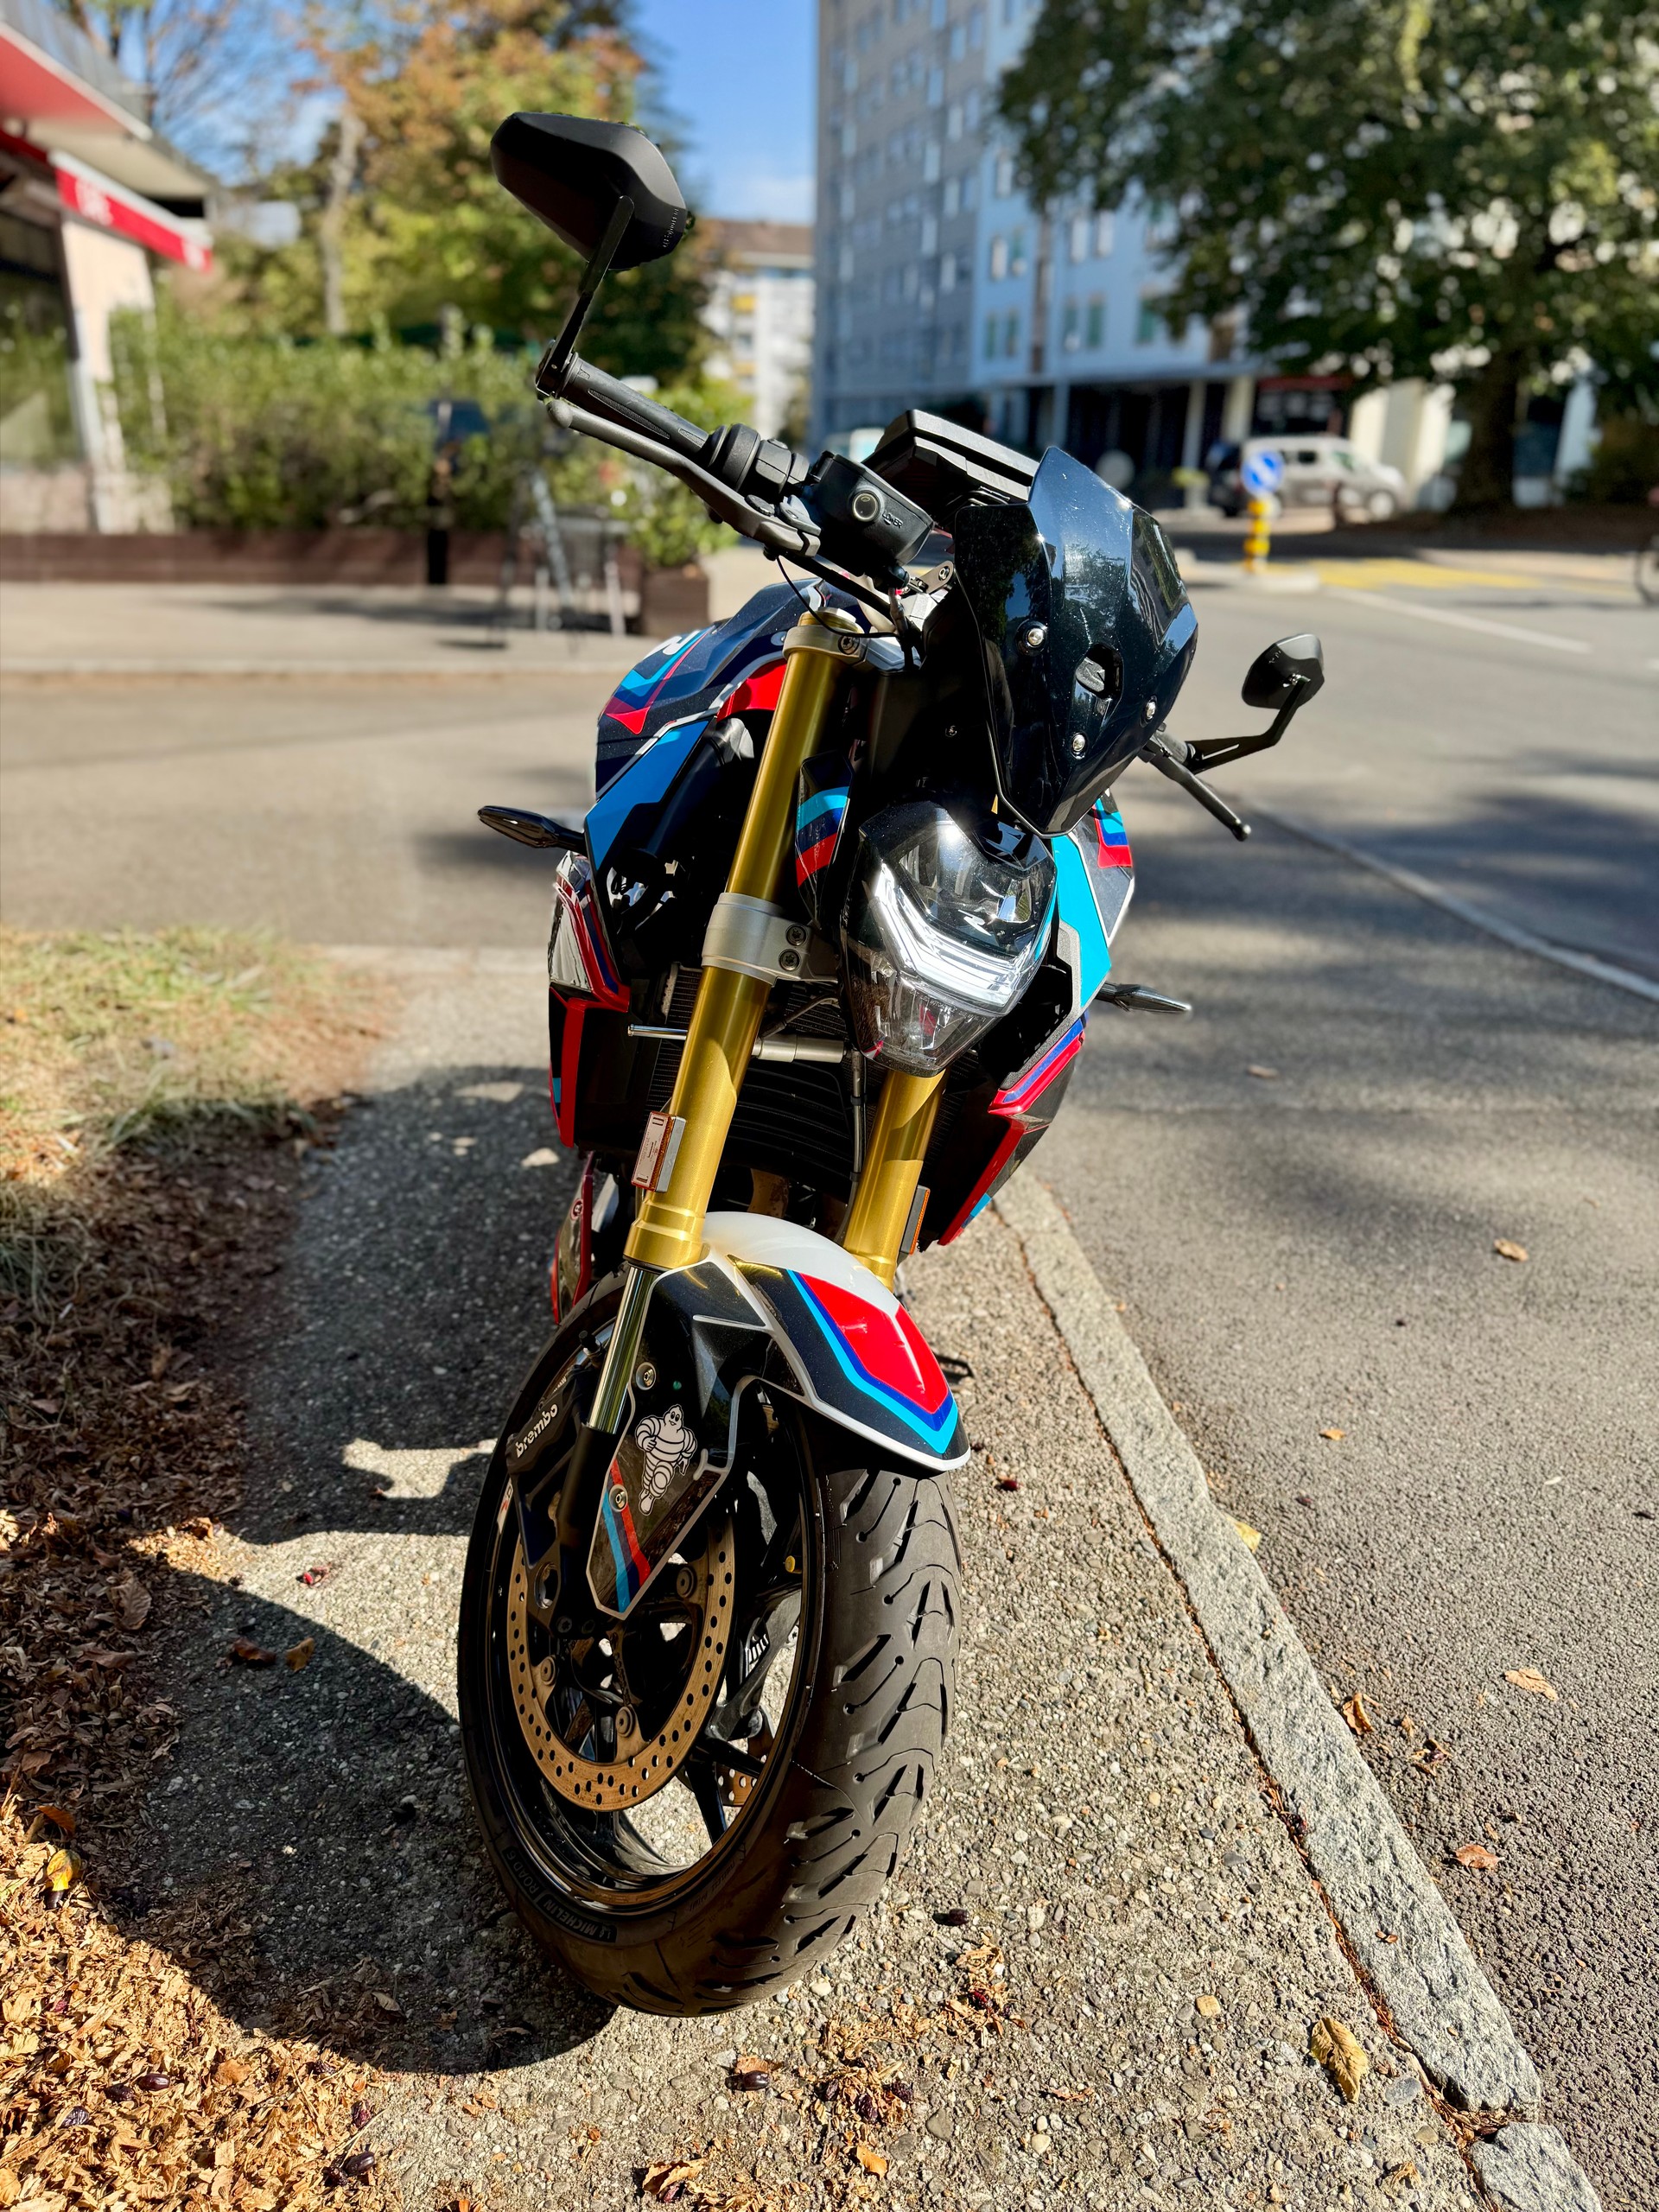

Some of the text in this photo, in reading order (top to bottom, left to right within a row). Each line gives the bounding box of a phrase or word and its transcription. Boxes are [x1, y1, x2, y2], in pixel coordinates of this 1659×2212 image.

[515, 1404, 558, 1459] brembo
[506, 1850, 539, 1894] ROAD 6
[543, 1900, 599, 1936] MICHELIN
